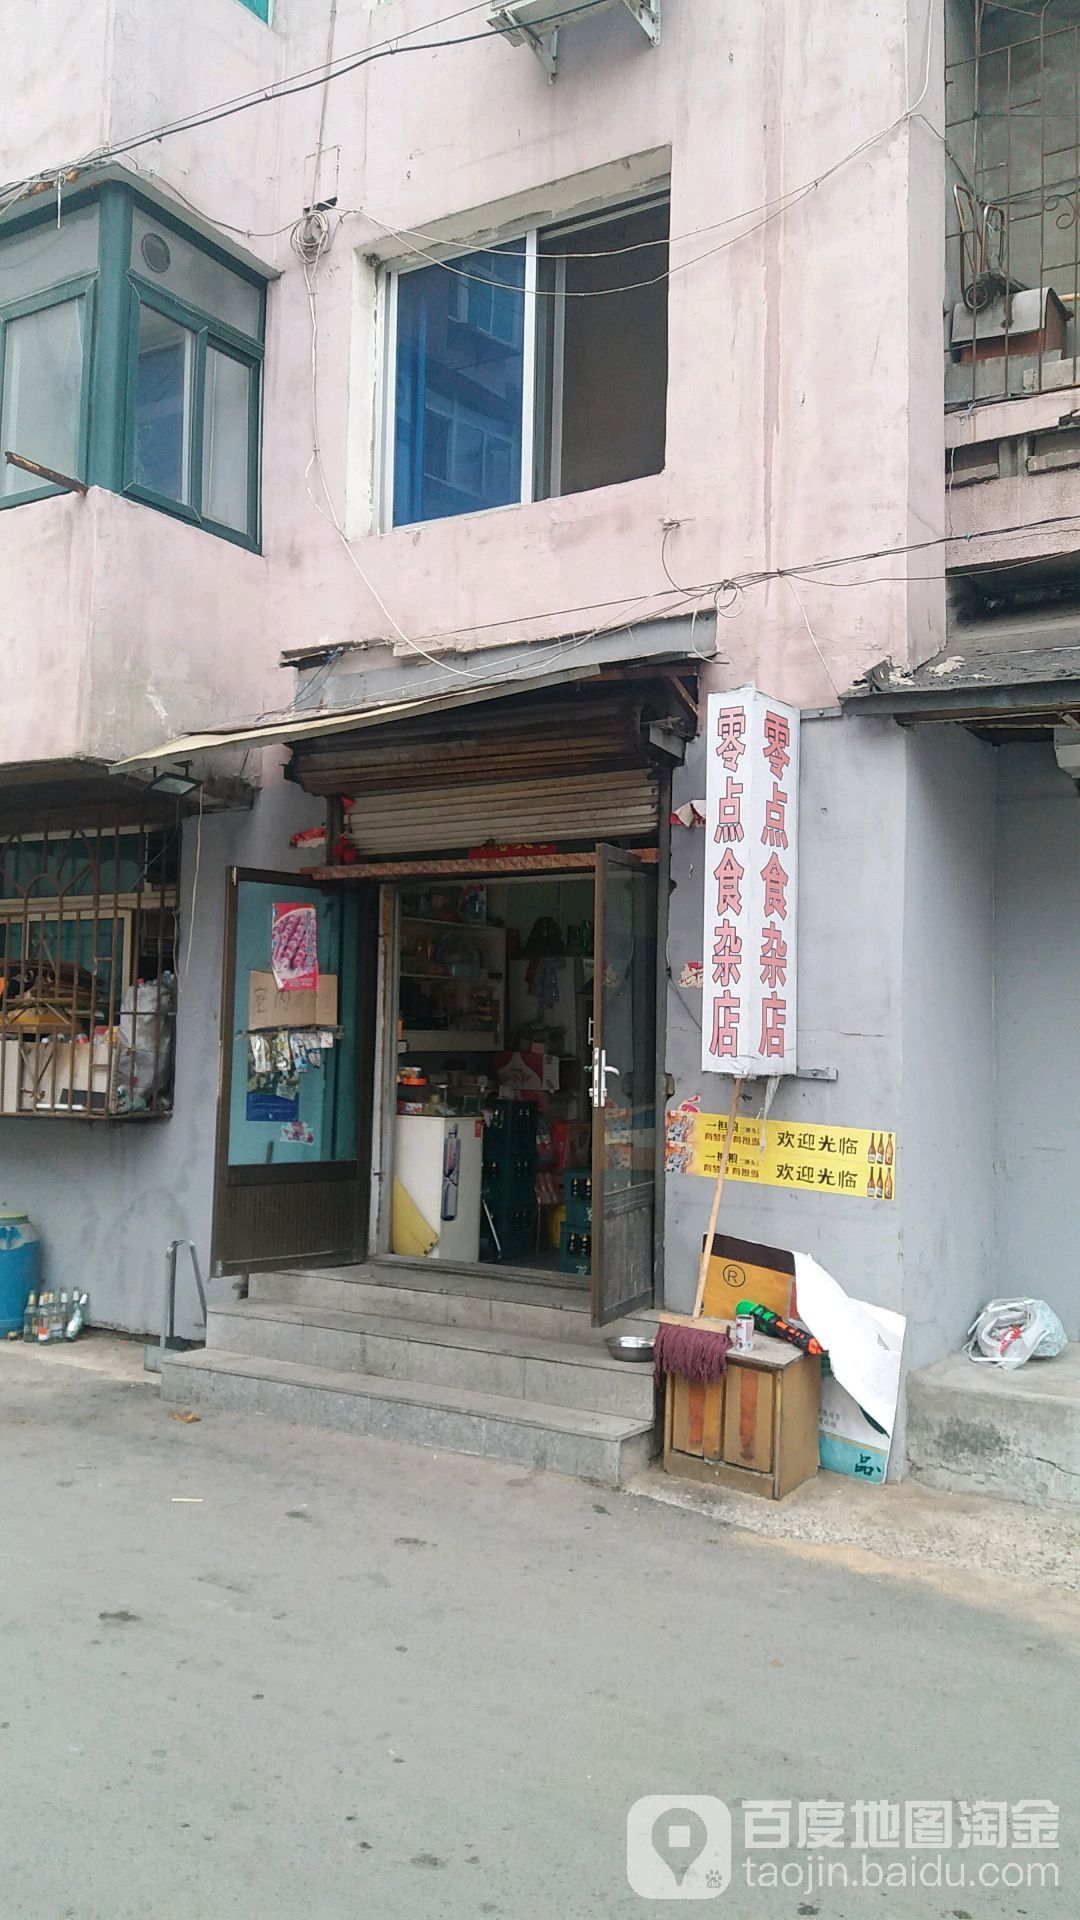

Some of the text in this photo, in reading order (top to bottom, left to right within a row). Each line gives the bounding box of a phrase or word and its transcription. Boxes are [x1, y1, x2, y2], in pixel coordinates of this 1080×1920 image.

[709, 705, 747, 1059] 零点食杂店
[758, 709, 791, 1059] 零点食杂店
[733, 1135, 760, 1147] 有担当
[777, 1130, 859, 1156] 欢迎光临
[732, 1167, 760, 1178] 有担当
[776, 1163, 858, 1189] 欢迎光临
